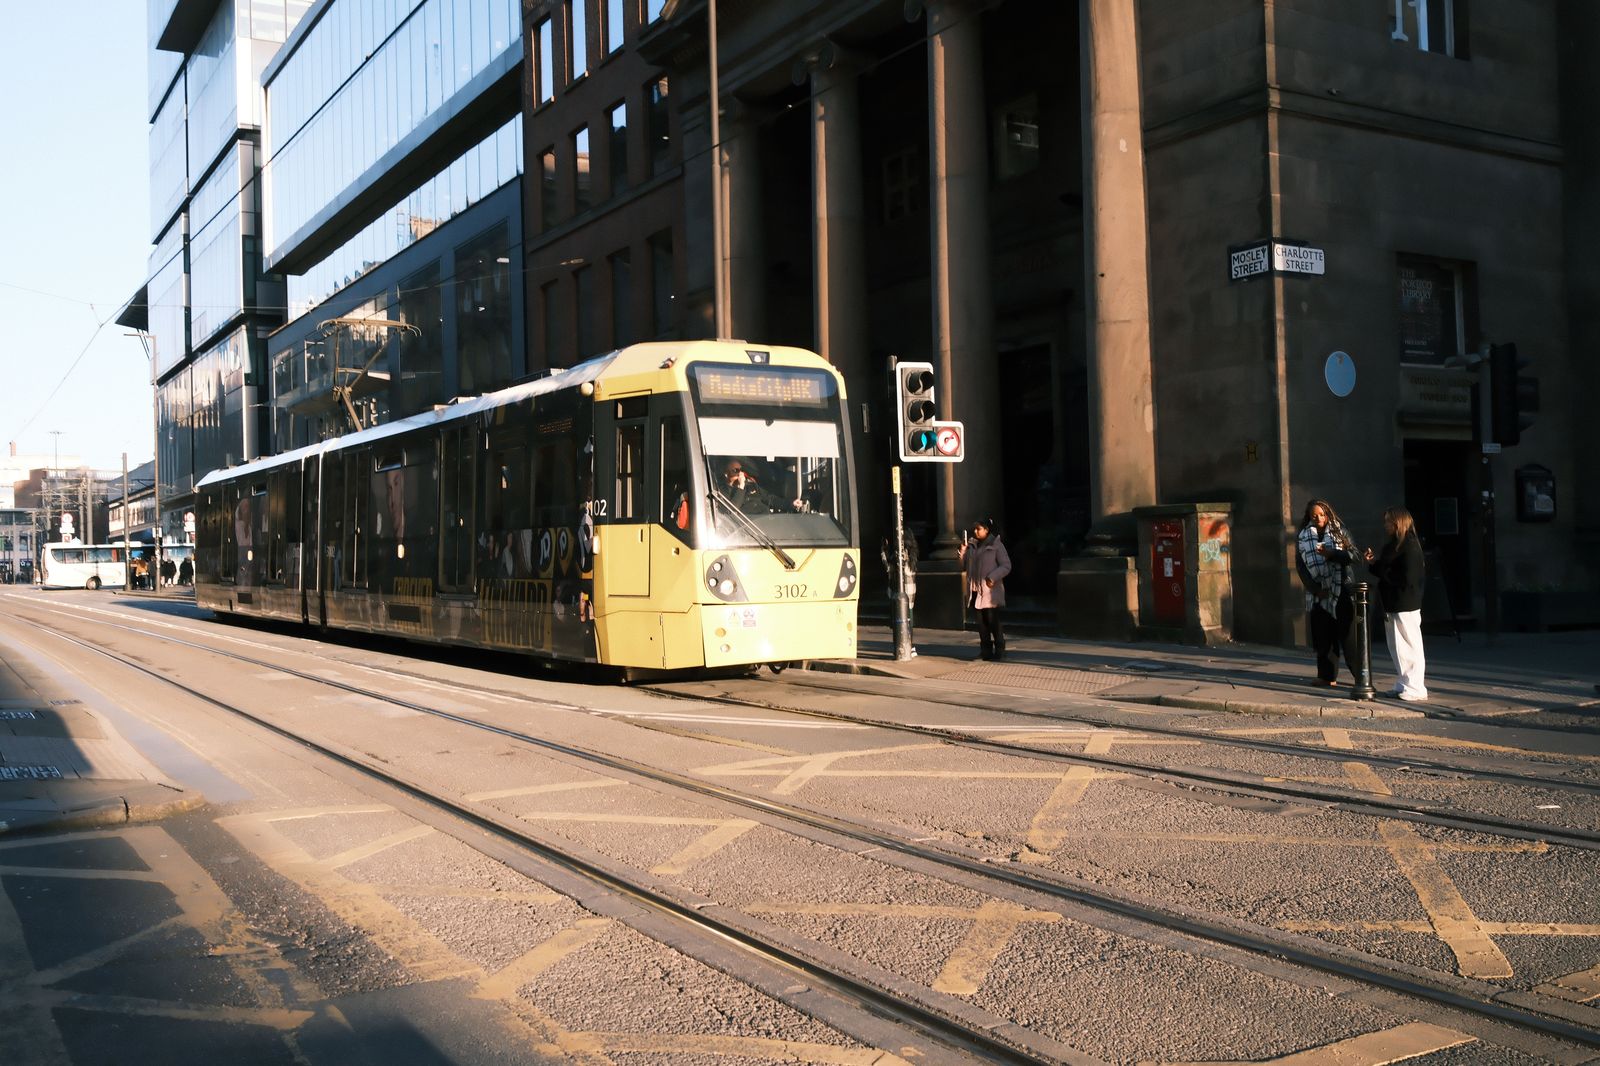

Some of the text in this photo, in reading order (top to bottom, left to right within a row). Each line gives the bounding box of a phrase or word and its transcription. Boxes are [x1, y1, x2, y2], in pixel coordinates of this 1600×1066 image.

[1232, 247, 1267, 265] MOSLEY
[1275, 247, 1324, 261] CHARLOTTE
[1233, 260, 1264, 277] STREET
[1285, 259, 1315, 271] STREET
[709, 374, 812, 401] MediaCityUK
[774, 584, 808, 599] 3102
